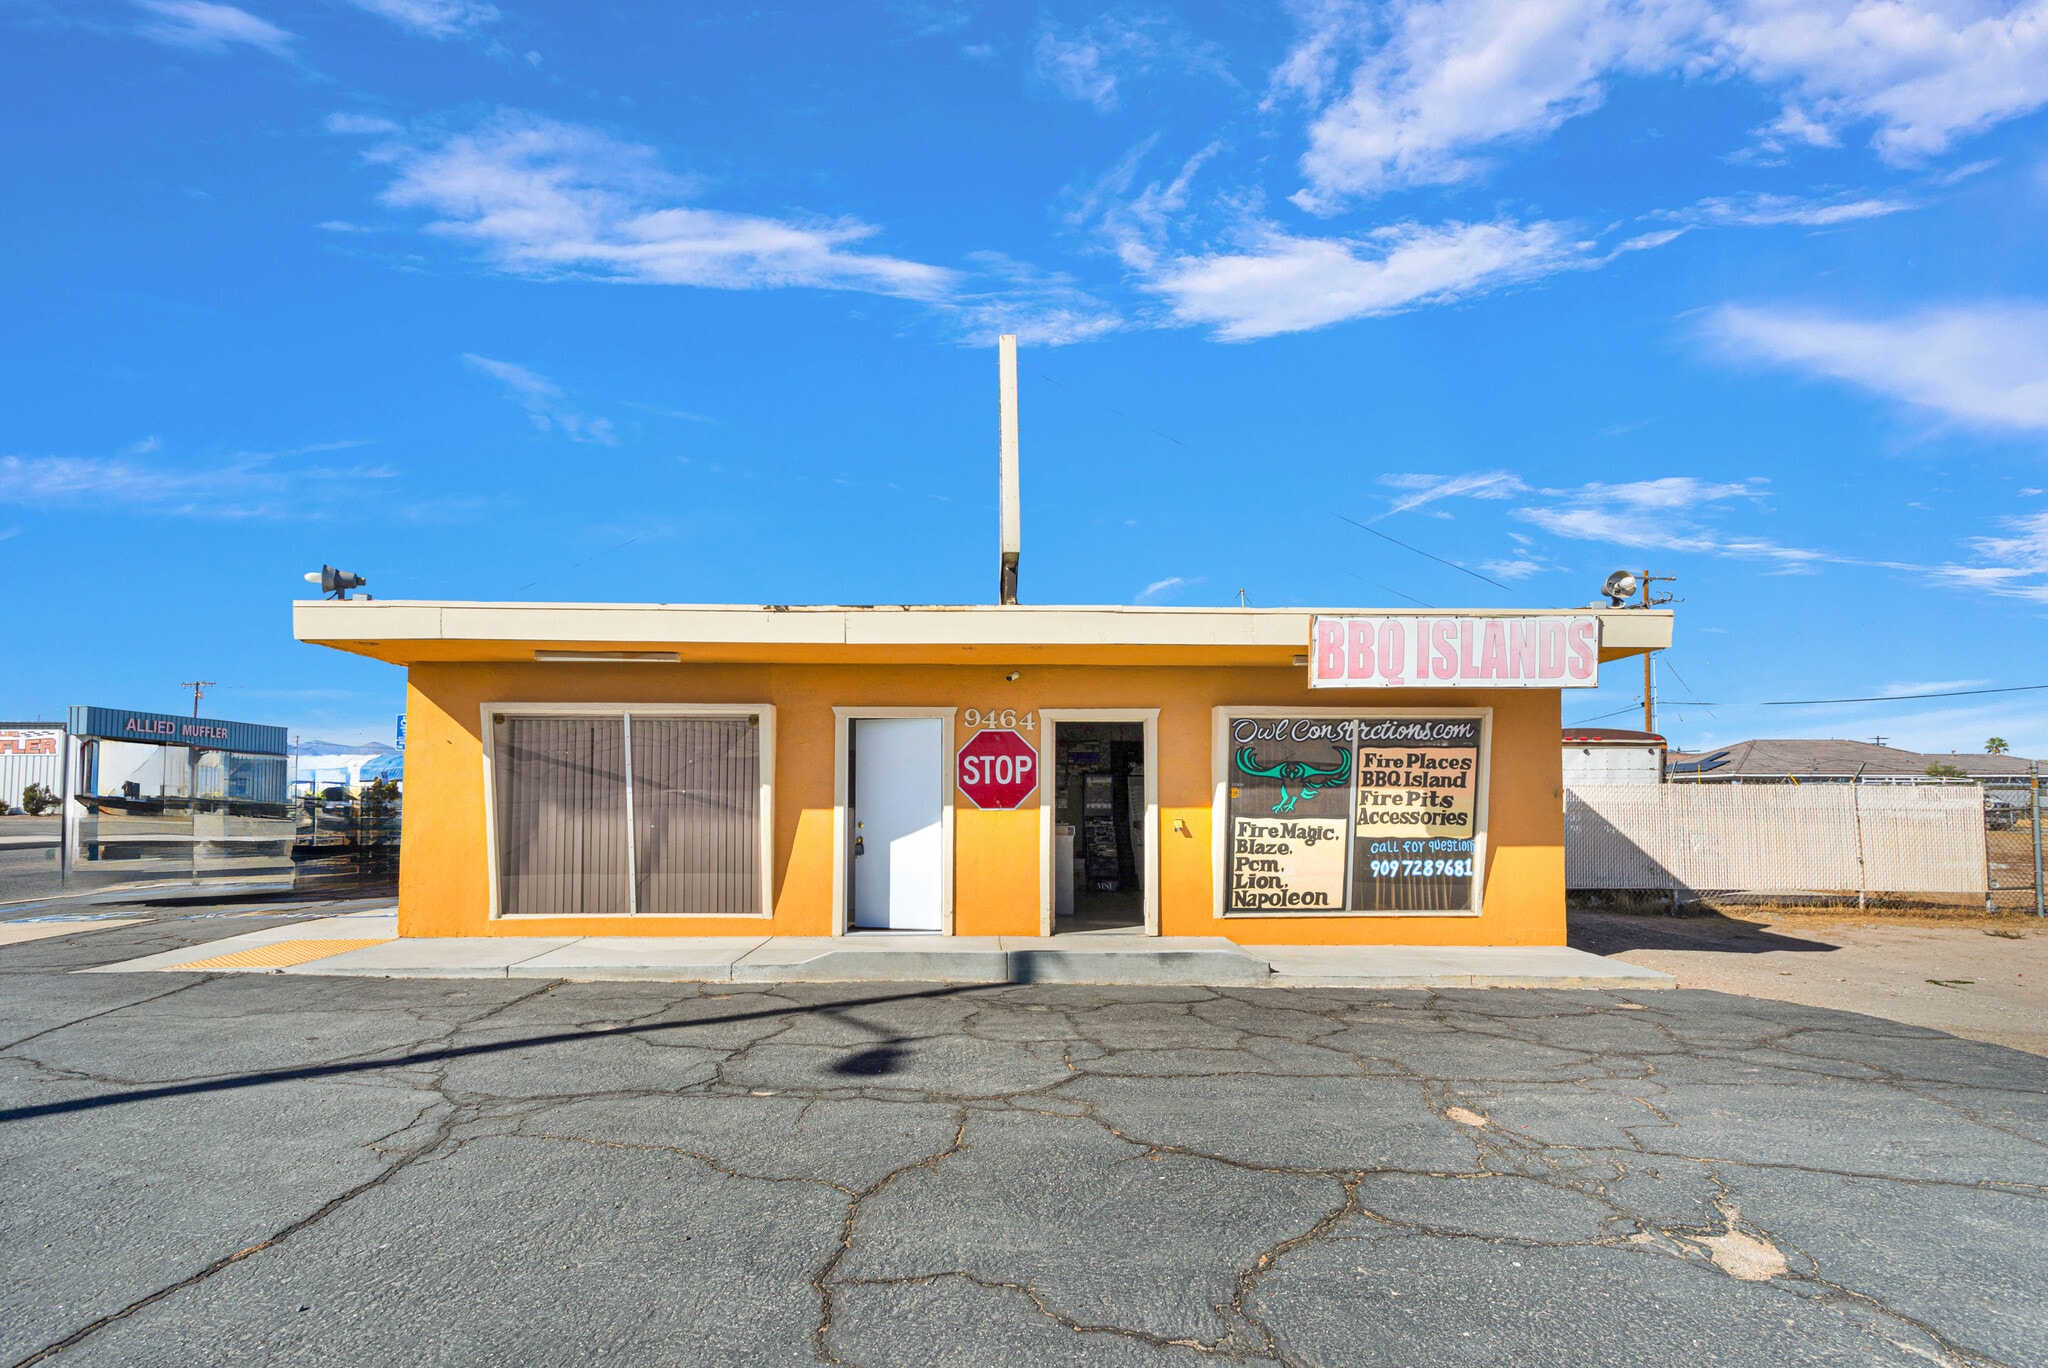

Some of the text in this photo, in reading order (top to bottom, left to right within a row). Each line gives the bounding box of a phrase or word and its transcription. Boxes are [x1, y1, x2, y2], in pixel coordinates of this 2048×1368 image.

[1317, 619, 1594, 685] BBQ ISLANDS
[126, 718, 228, 739] ALLIED MUFFLER
[963, 708, 1036, 731] 9464
[1232, 718, 1288, 743] Owl
[963, 755, 1032, 785] STOP
[1363, 753, 1472, 770] Fire Places
[1361, 770, 1467, 789] BBQ Island
[1359, 790, 1454, 809] Fire Pits
[1357, 807, 1469, 826] Accessories
[1237, 821, 1280, 838] Fire
[1369, 859, 1400, 878] 909
[1233, 889, 1330, 909] Napoleon
